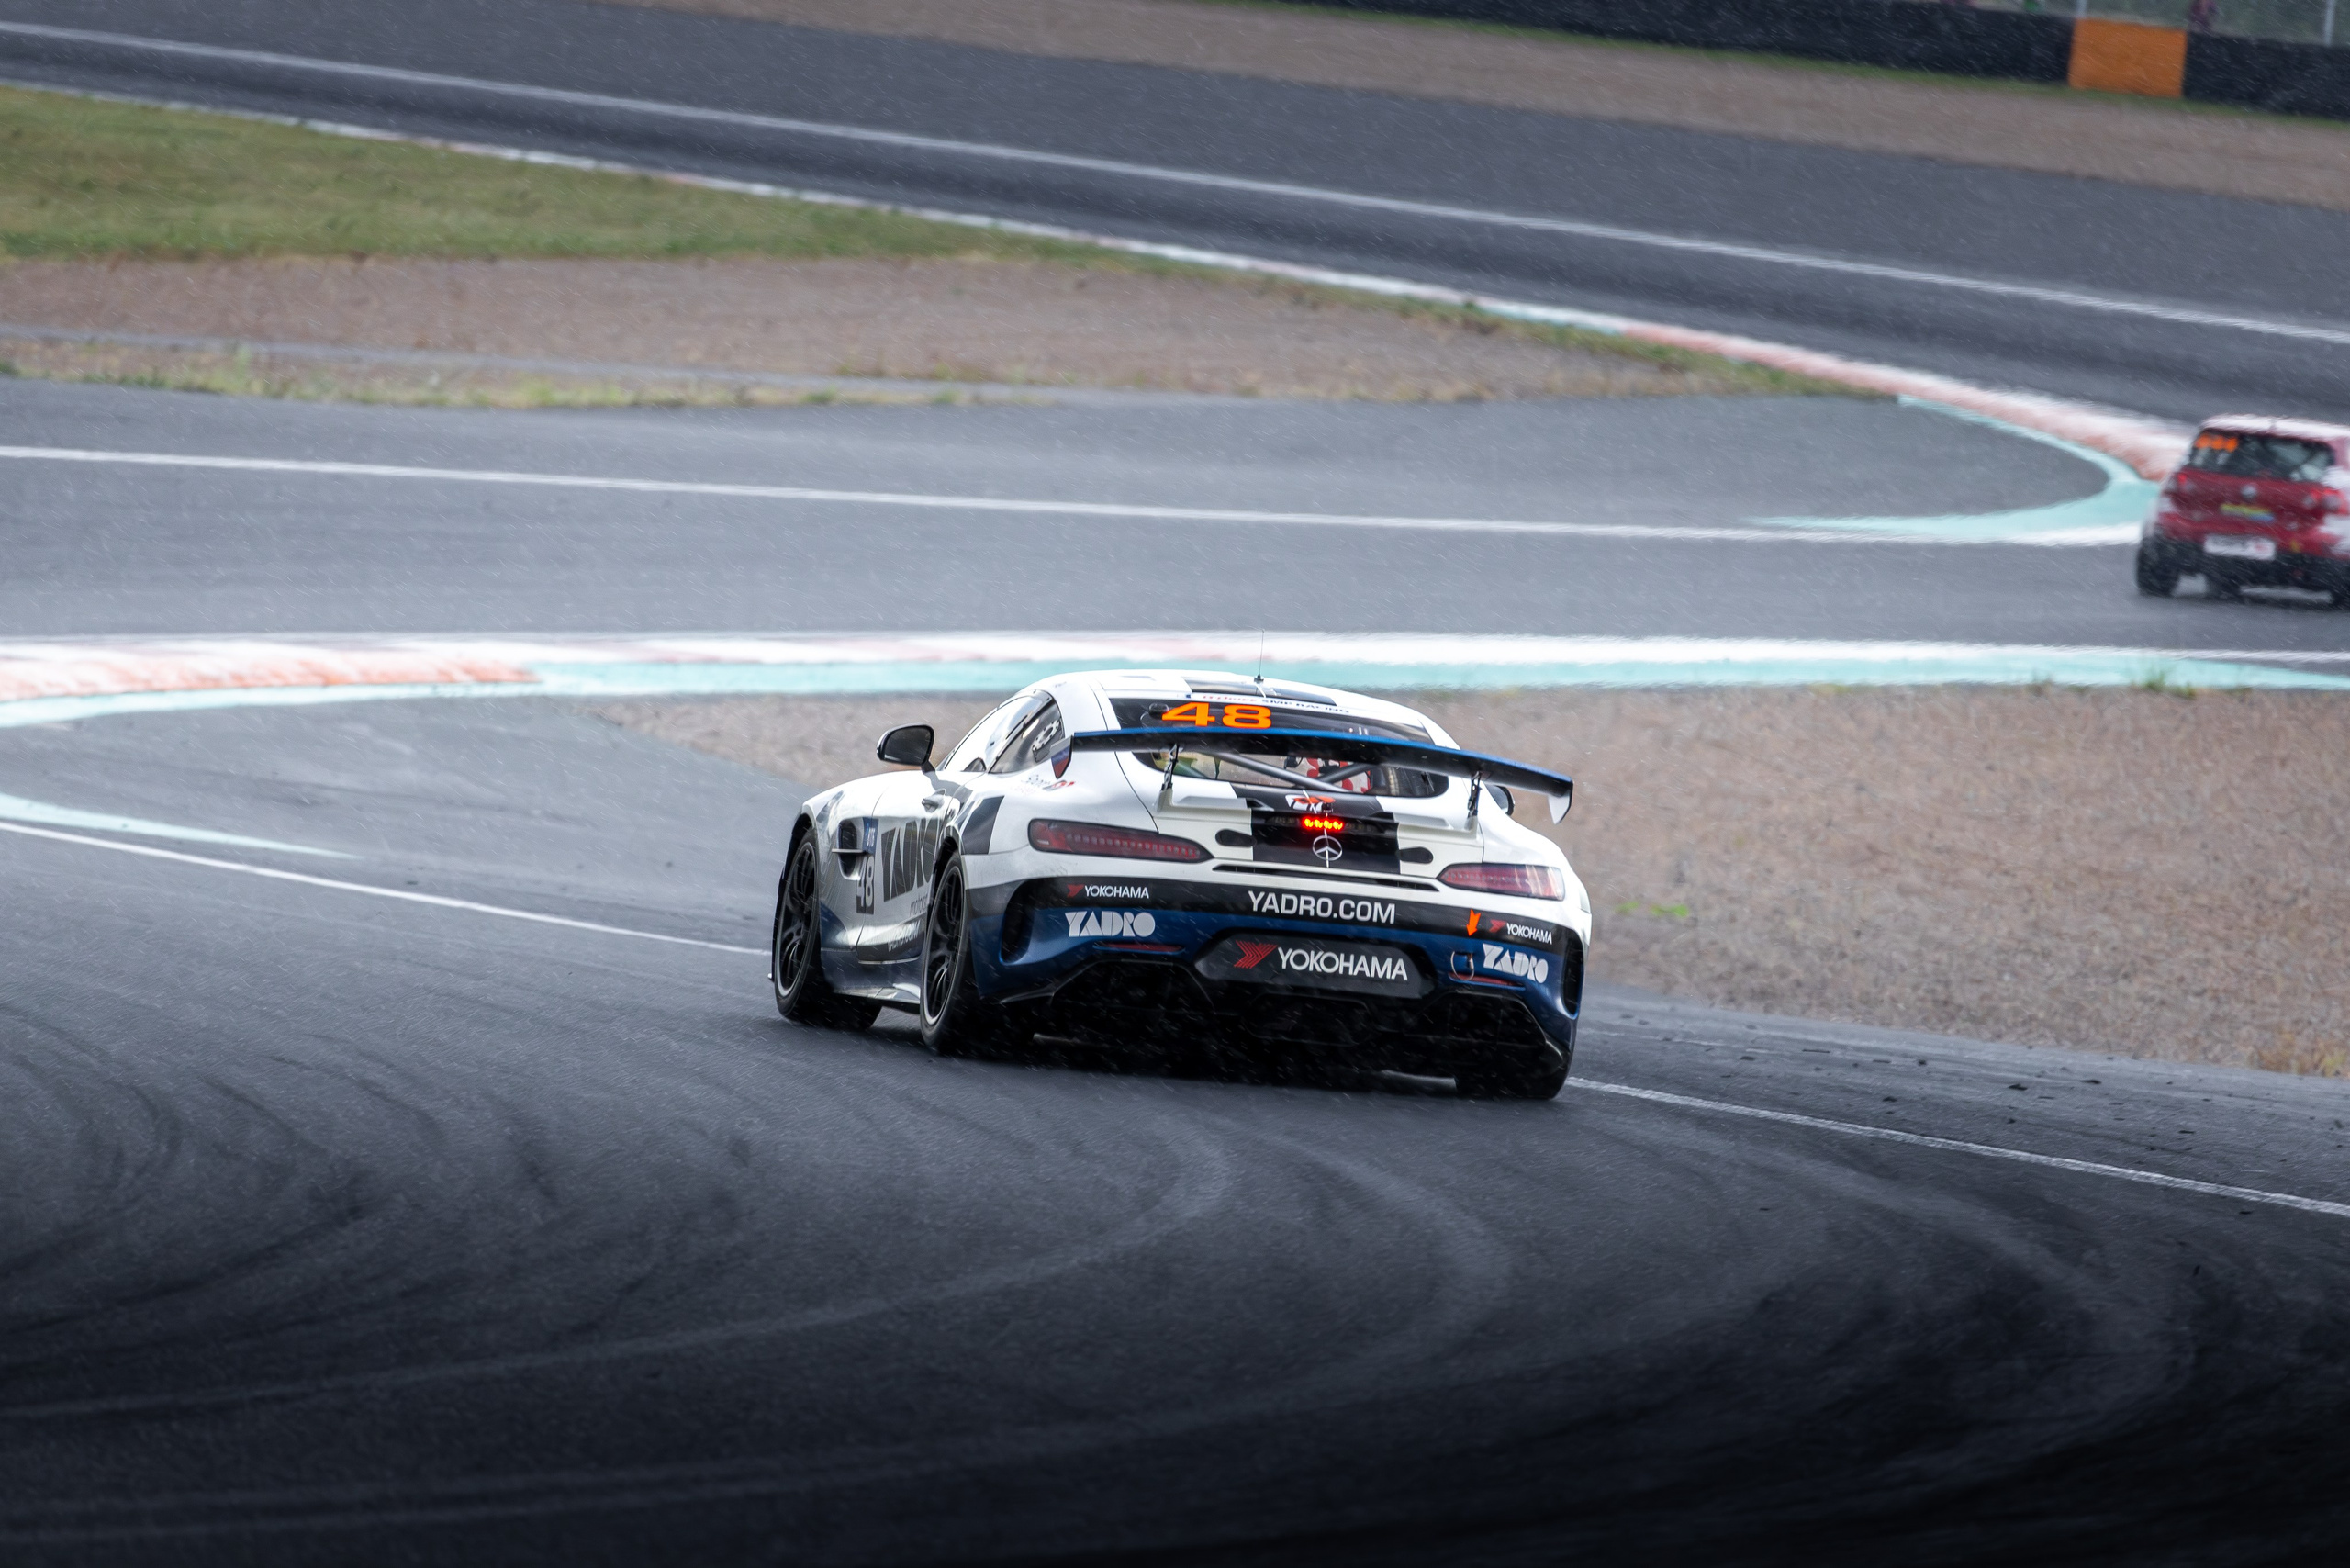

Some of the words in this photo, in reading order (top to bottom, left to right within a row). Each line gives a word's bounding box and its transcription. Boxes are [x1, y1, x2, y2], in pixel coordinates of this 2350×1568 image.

[1161, 701, 1272, 729] 48
[856, 854, 875, 908] 48
[1084, 884, 1150, 899] YOKOHAMA
[1248, 890, 1396, 924] YADRO.COM
[1064, 910, 1156, 937] YADRO
[1506, 922, 1552, 946] YOKOHAMA
[1277, 946, 1408, 981] YOKOHAMA
[1482, 942, 1549, 984] YADRO
